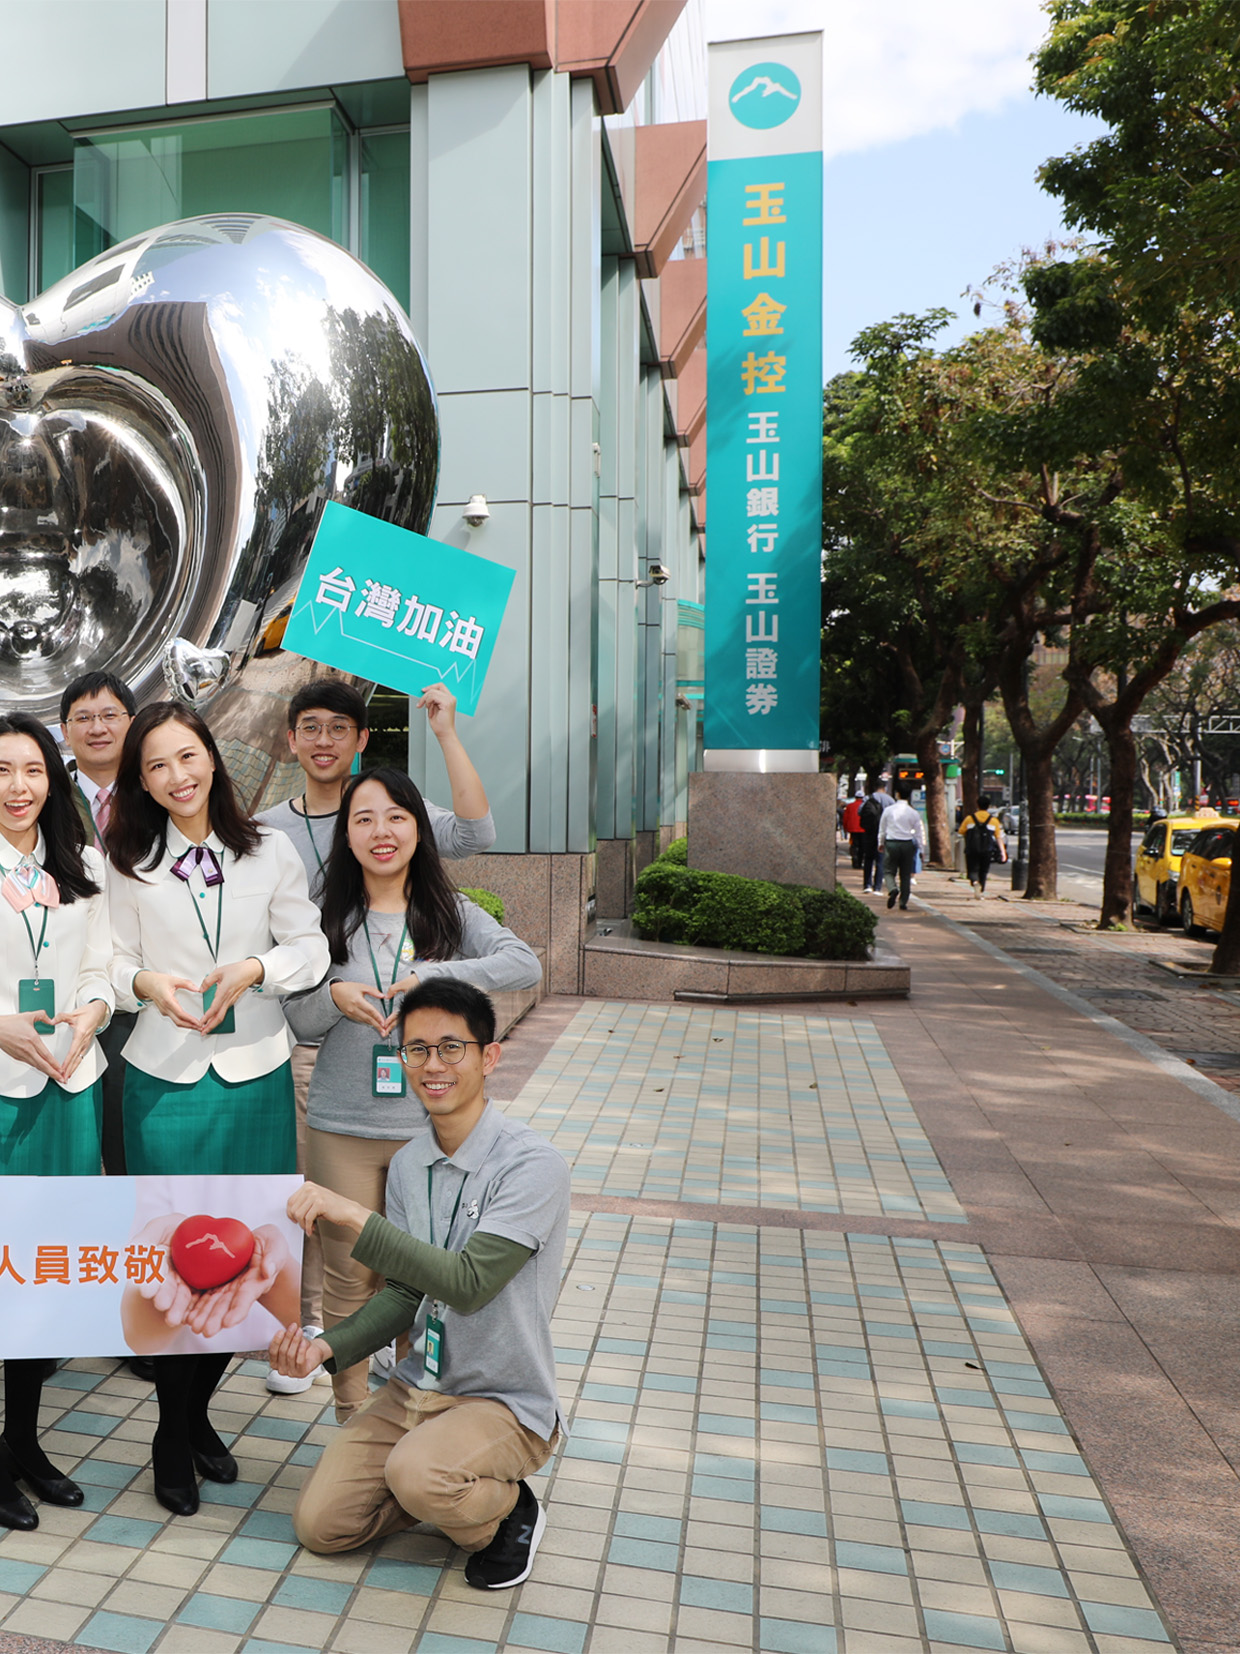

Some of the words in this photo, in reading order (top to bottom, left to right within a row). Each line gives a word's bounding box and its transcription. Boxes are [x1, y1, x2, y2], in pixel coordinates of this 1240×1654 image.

[741, 182, 786, 395] 玉山金控
[745, 411, 780, 553] 玉山銀行
[315, 566, 485, 660] 台灣加油
[744, 573, 779, 715] 玉山證券
